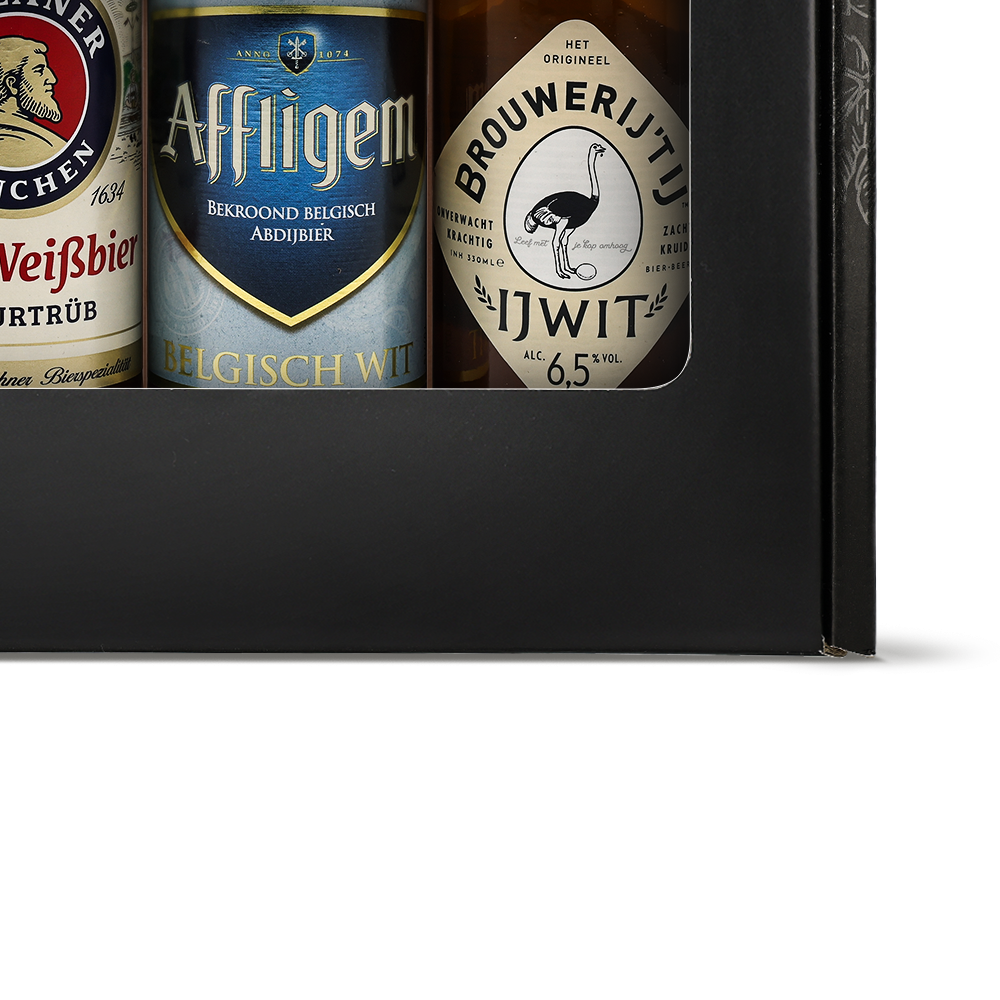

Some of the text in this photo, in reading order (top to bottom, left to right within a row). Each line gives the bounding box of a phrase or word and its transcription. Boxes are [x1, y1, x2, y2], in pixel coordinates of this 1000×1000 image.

[236, 50, 350, 58] ANNO 1074
[565, 39, 590, 50] HET
[543, 54, 611, 66] ORIGINEEL
[90, 180, 125, 208] 1634
[207, 200, 376, 220] BEKROOND BELGISCH
[437, 205, 494, 231] ONVERWACHT
[249, 226, 335, 246] ABDIJBIER
[446, 228, 493, 249] KRACHTIG
[663, 223, 689, 236] ZACH
[450, 249, 464, 259] INH
[513, 236, 533, 247] Leef
[534, 239, 549, 247] met
[599, 240, 632, 253] omhoog
[660, 241, 689, 255] KRUID
[498, 289, 650, 342] IJWIT
[40, 356, 132, 386] Bierspezialität
[163, 339, 414, 388] BELGISCH WIT
[523, 350, 545, 361] ALC.
[547, 352, 590, 388] 6,5
